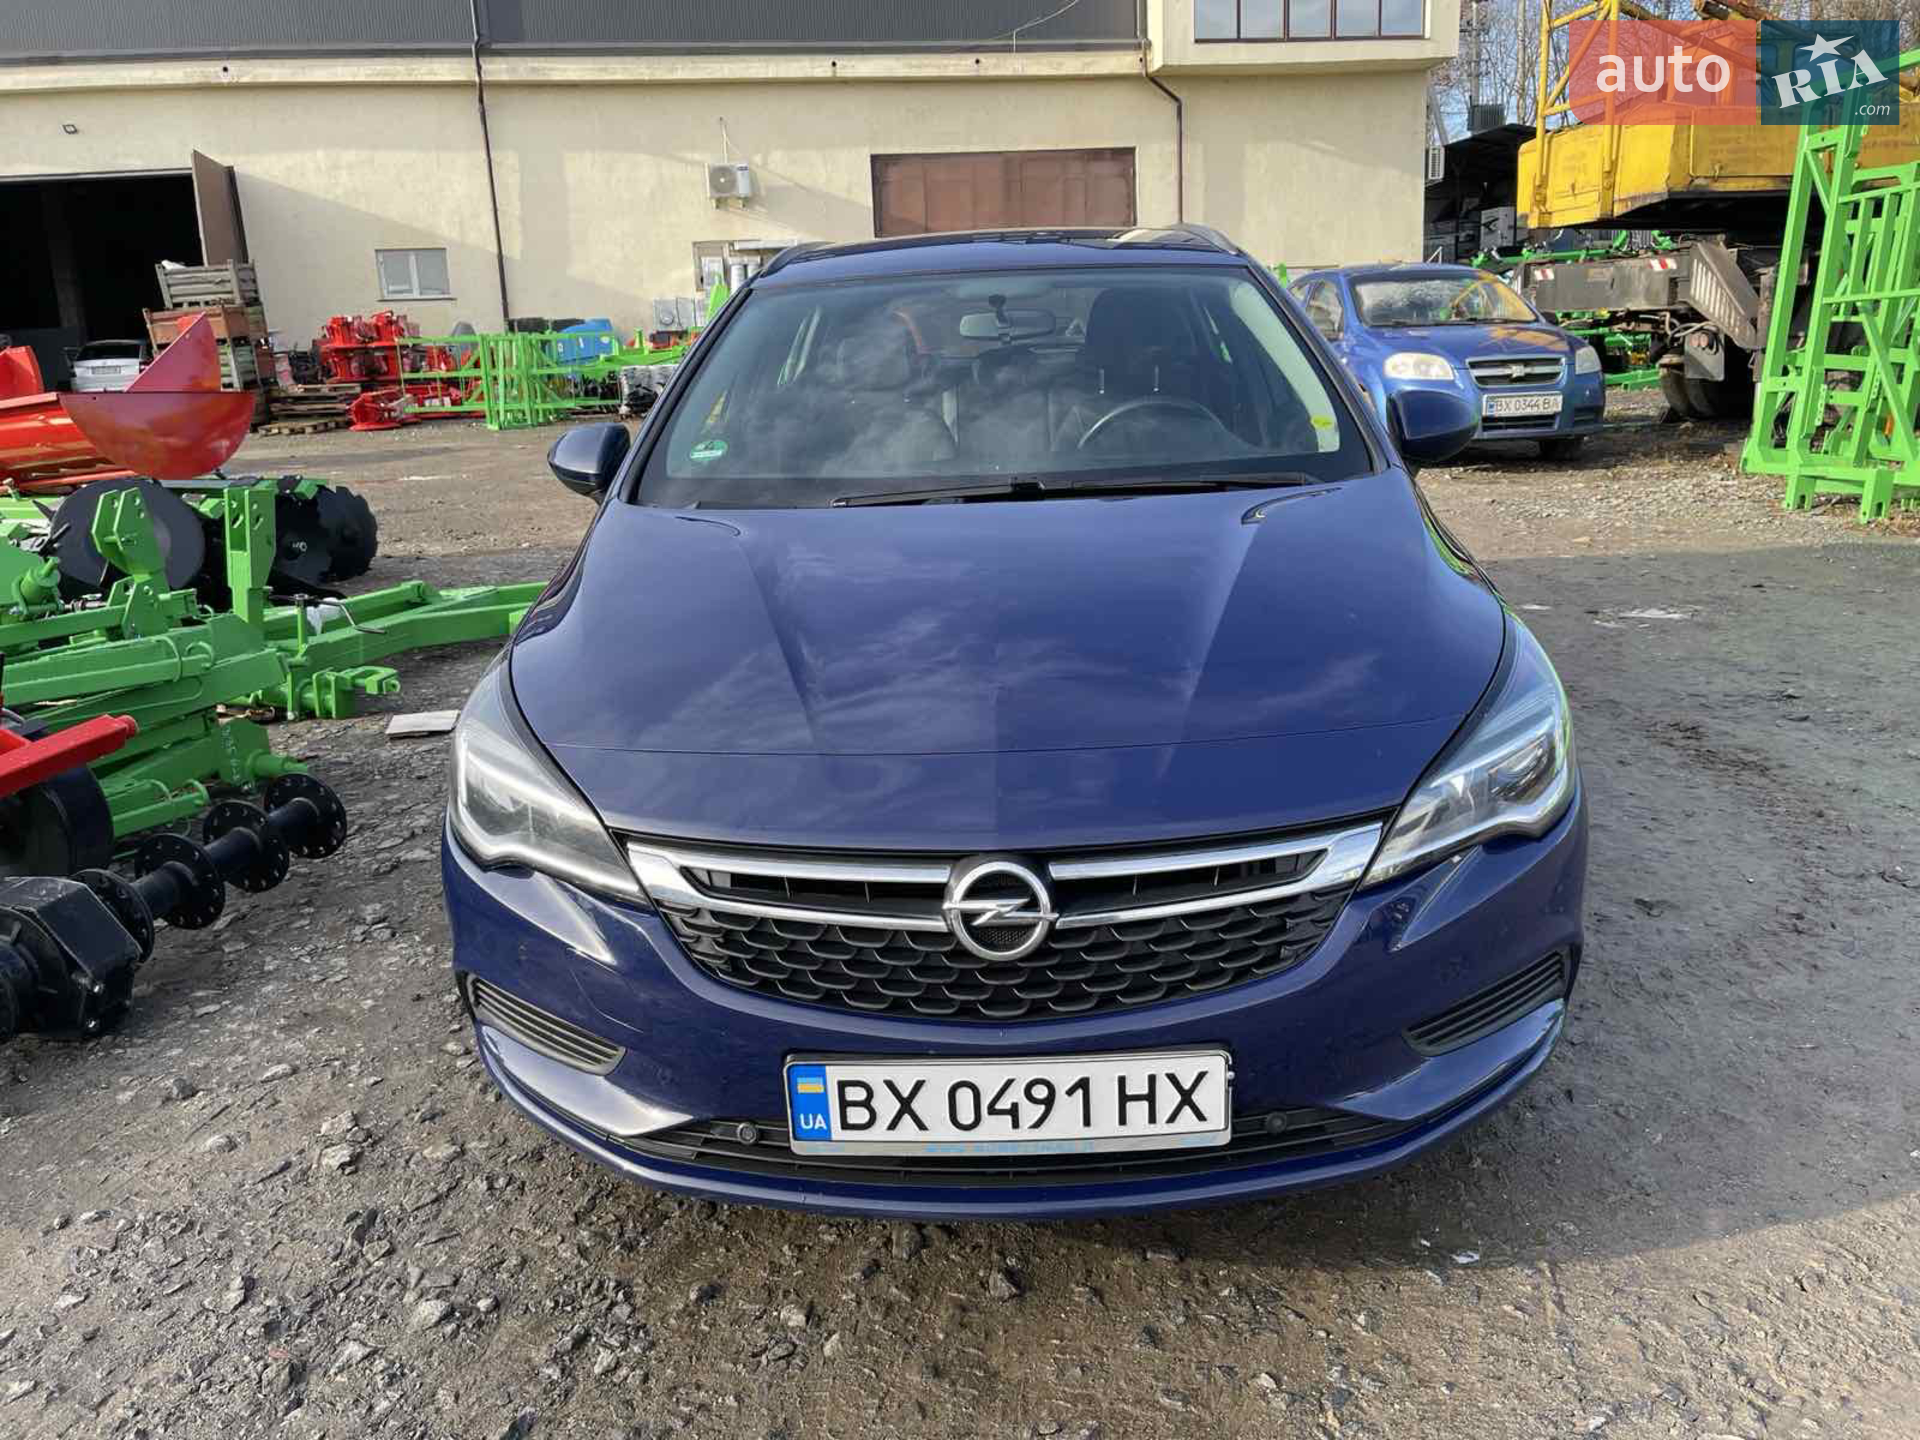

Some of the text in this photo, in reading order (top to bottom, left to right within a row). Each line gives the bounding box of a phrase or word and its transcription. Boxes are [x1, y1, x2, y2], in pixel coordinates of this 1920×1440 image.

[837, 1071, 1208, 1131] BX 0491 HX
[800, 1113, 827, 1130] UA
